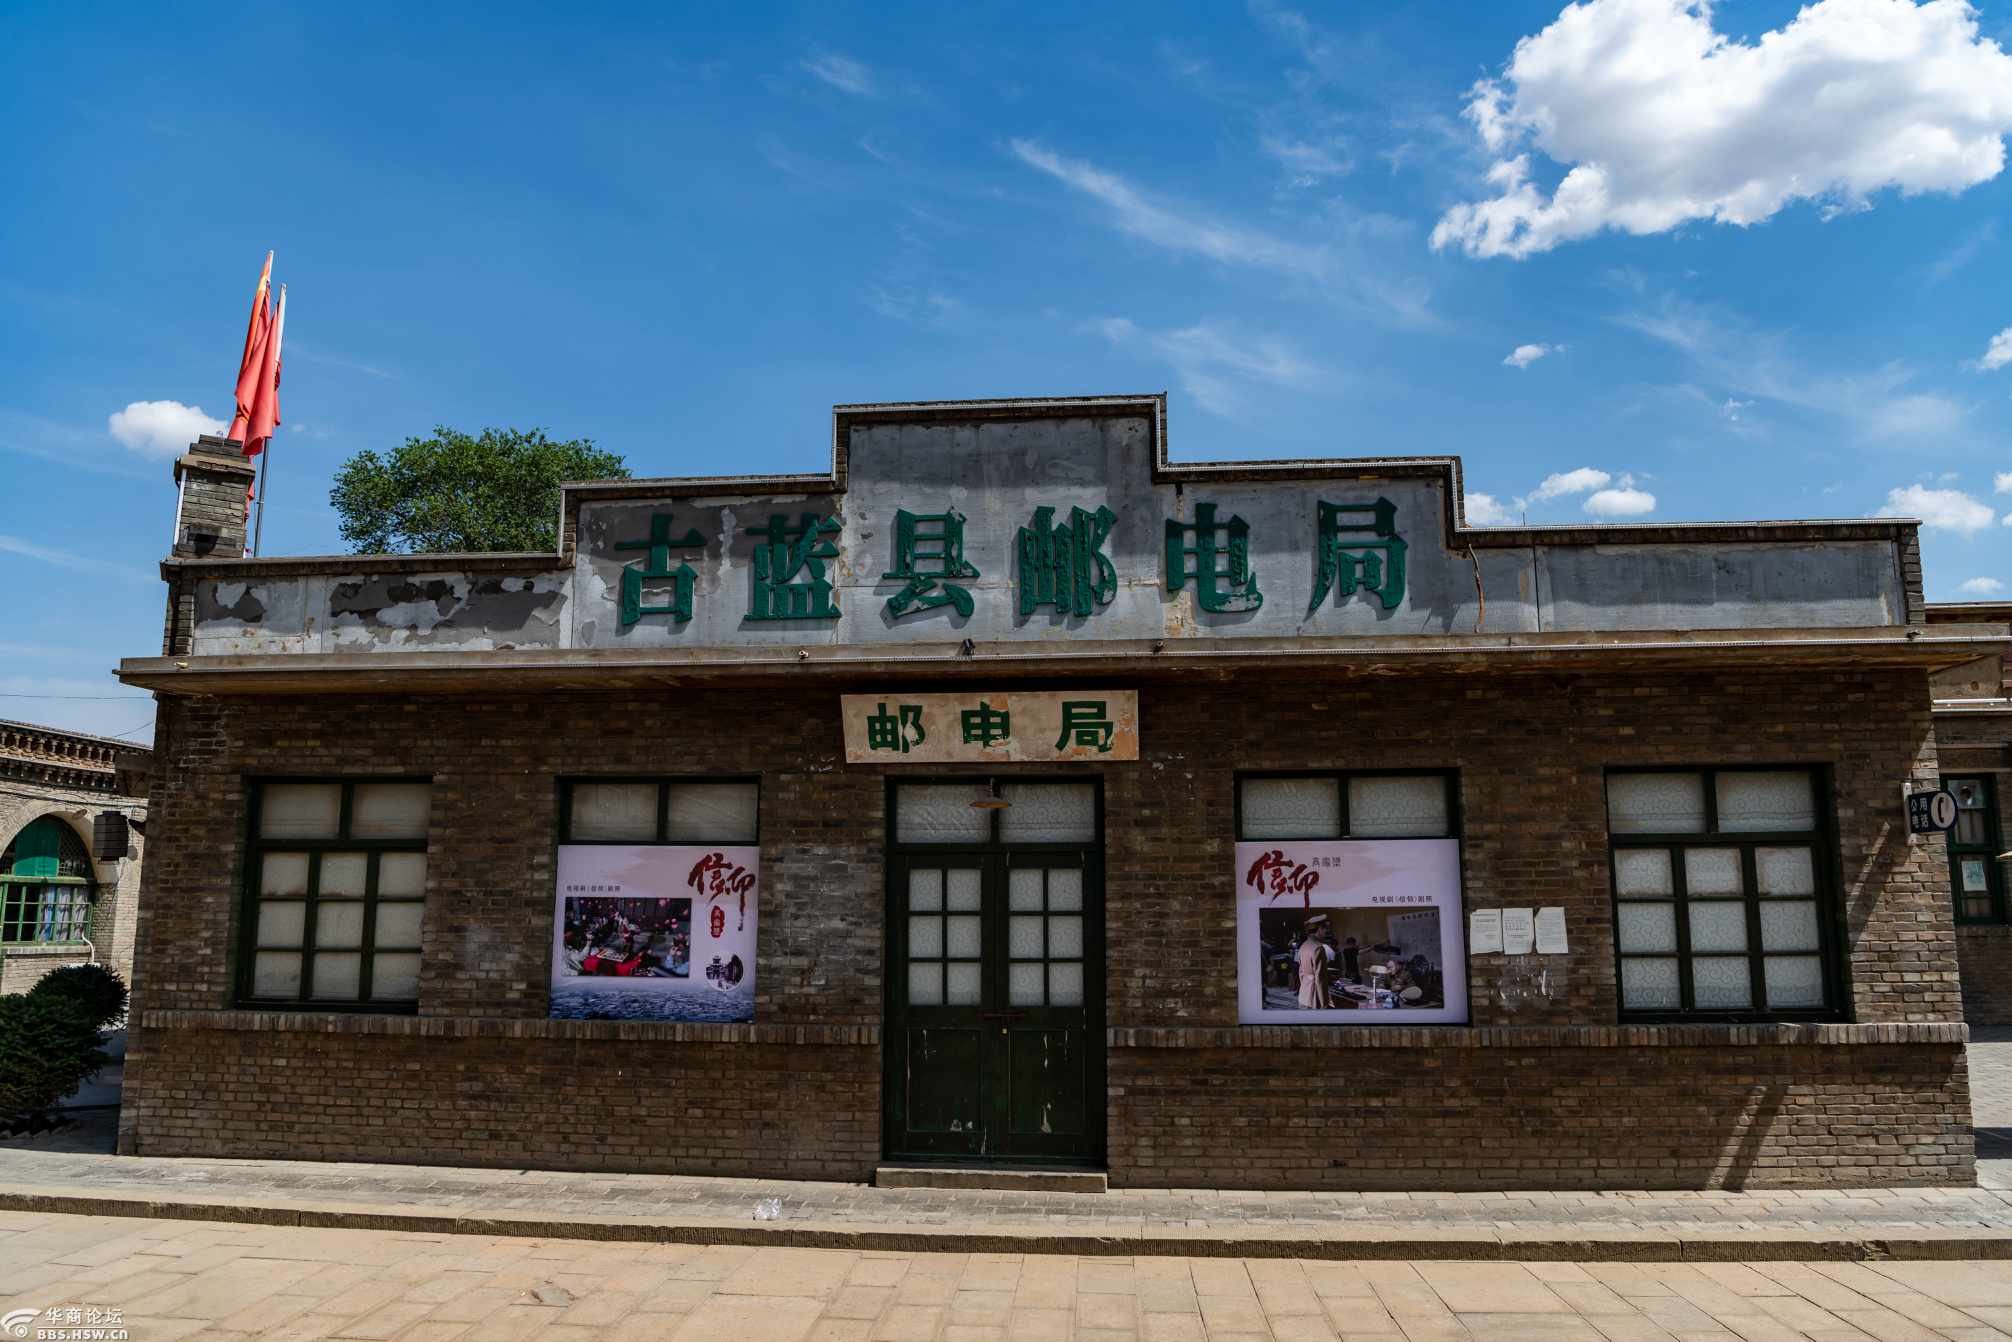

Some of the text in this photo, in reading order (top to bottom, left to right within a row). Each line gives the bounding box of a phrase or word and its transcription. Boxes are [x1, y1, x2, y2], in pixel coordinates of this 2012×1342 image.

[614, 495, 1409, 624] 古蓝县邮电局
[866, 701, 1114, 753] 邮电局
[1910, 797, 1928, 812] 公用
[1911, 814, 1929, 829] 电话
[566, 884, 621, 893] 电视剧《信仰》剧照
[687, 852, 756, 932] 信仰
[1246, 850, 1320, 930] 信仰
[1371, 895, 1433, 903] 电视剧《信仰》剧照
